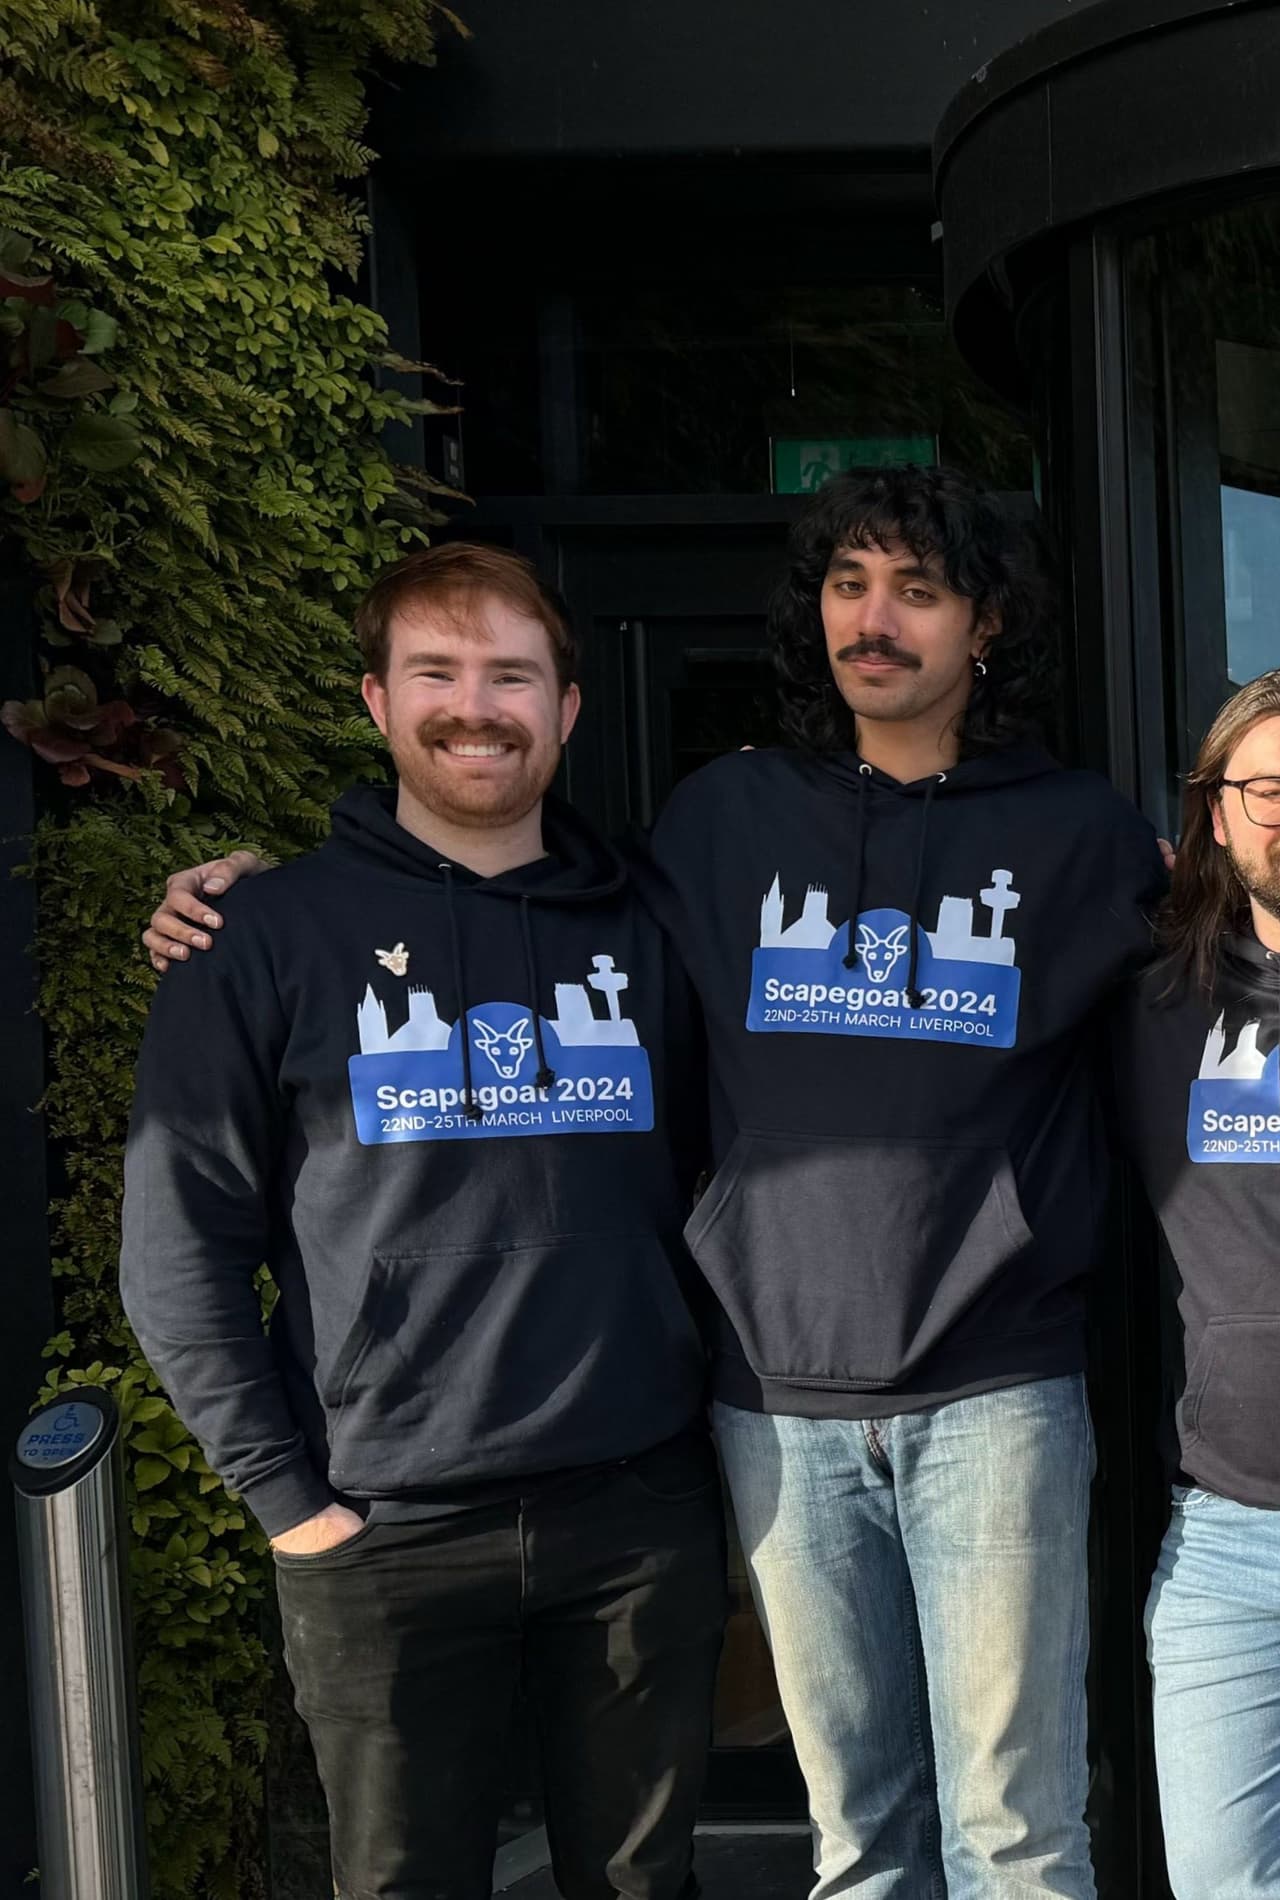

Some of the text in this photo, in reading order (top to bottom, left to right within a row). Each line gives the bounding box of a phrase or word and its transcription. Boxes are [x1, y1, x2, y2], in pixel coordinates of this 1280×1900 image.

[765, 978, 997, 1016] Scapegoat 2024
[763, 1009, 994, 1037] 22ND-25TH MARCH LIVERPOOL
[376, 1077, 634, 1112] Scapegoat 2024
[482, 1112, 542, 1127] MARCH
[552, 1108, 633, 1124] LIVERPOOL
[1203, 1139, 1280, 1153] 22ND-25TH
[27, 1433, 85, 1445] PRESS
[23, 1448, 38, 1457] TO
